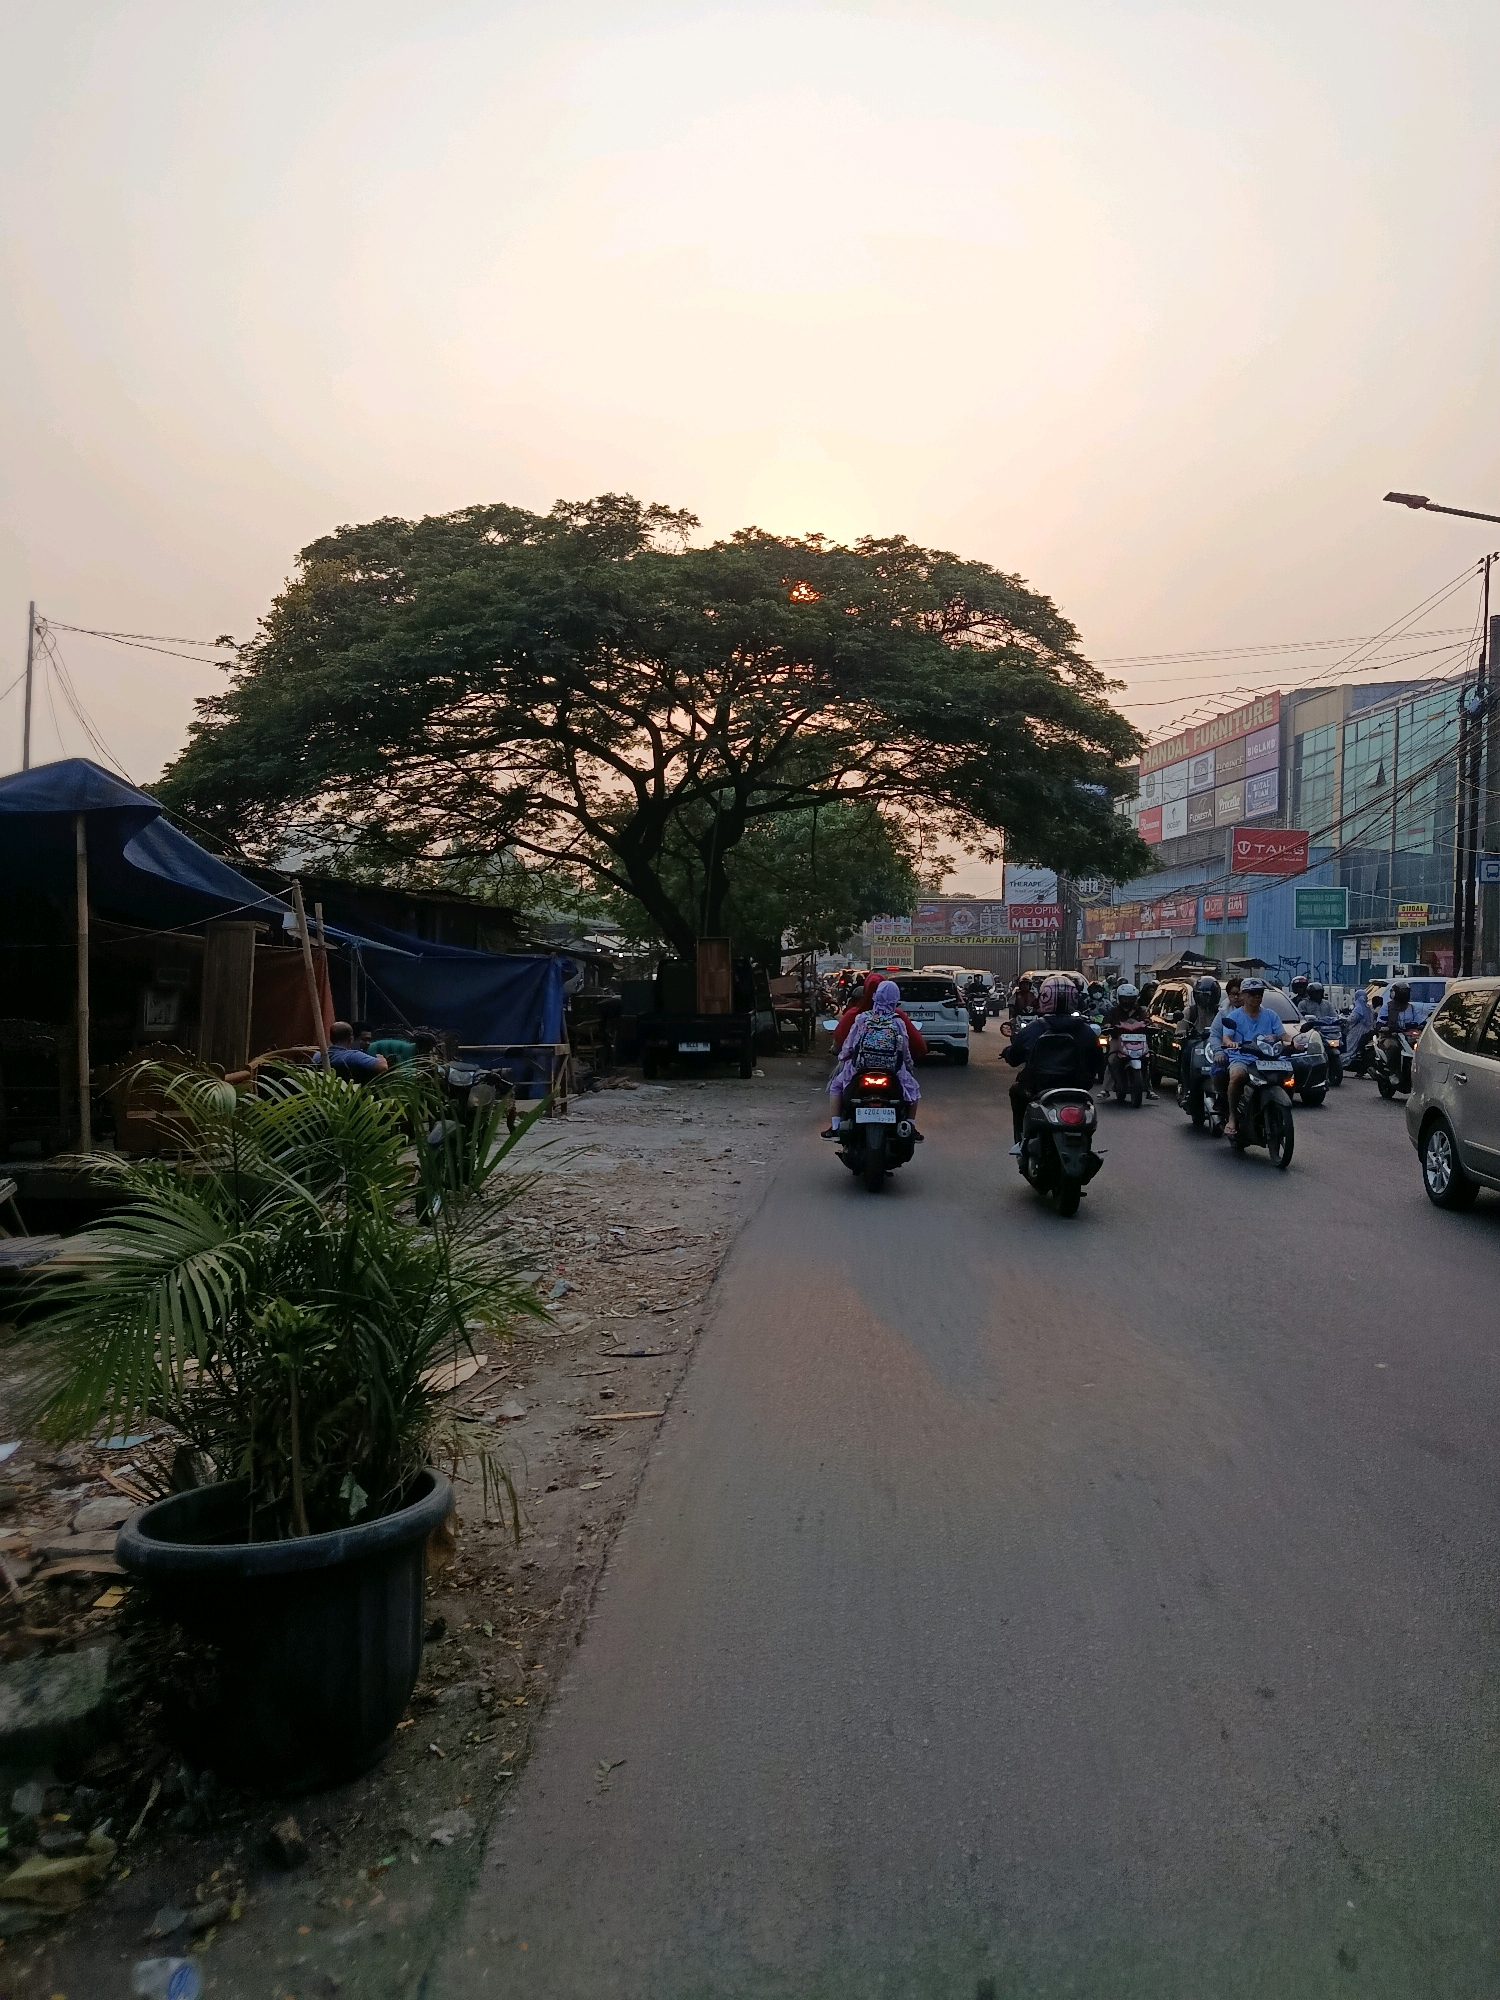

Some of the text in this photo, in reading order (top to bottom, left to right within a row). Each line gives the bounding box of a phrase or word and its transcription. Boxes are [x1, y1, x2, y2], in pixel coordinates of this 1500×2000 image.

[1143, 697, 1274, 771] HANDAL FURNITURE
[1247, 739, 1277, 757] BIGLAND
[1034, 906, 1060, 915] OPTIK
[1011, 917, 1060, 929] MEDIA
